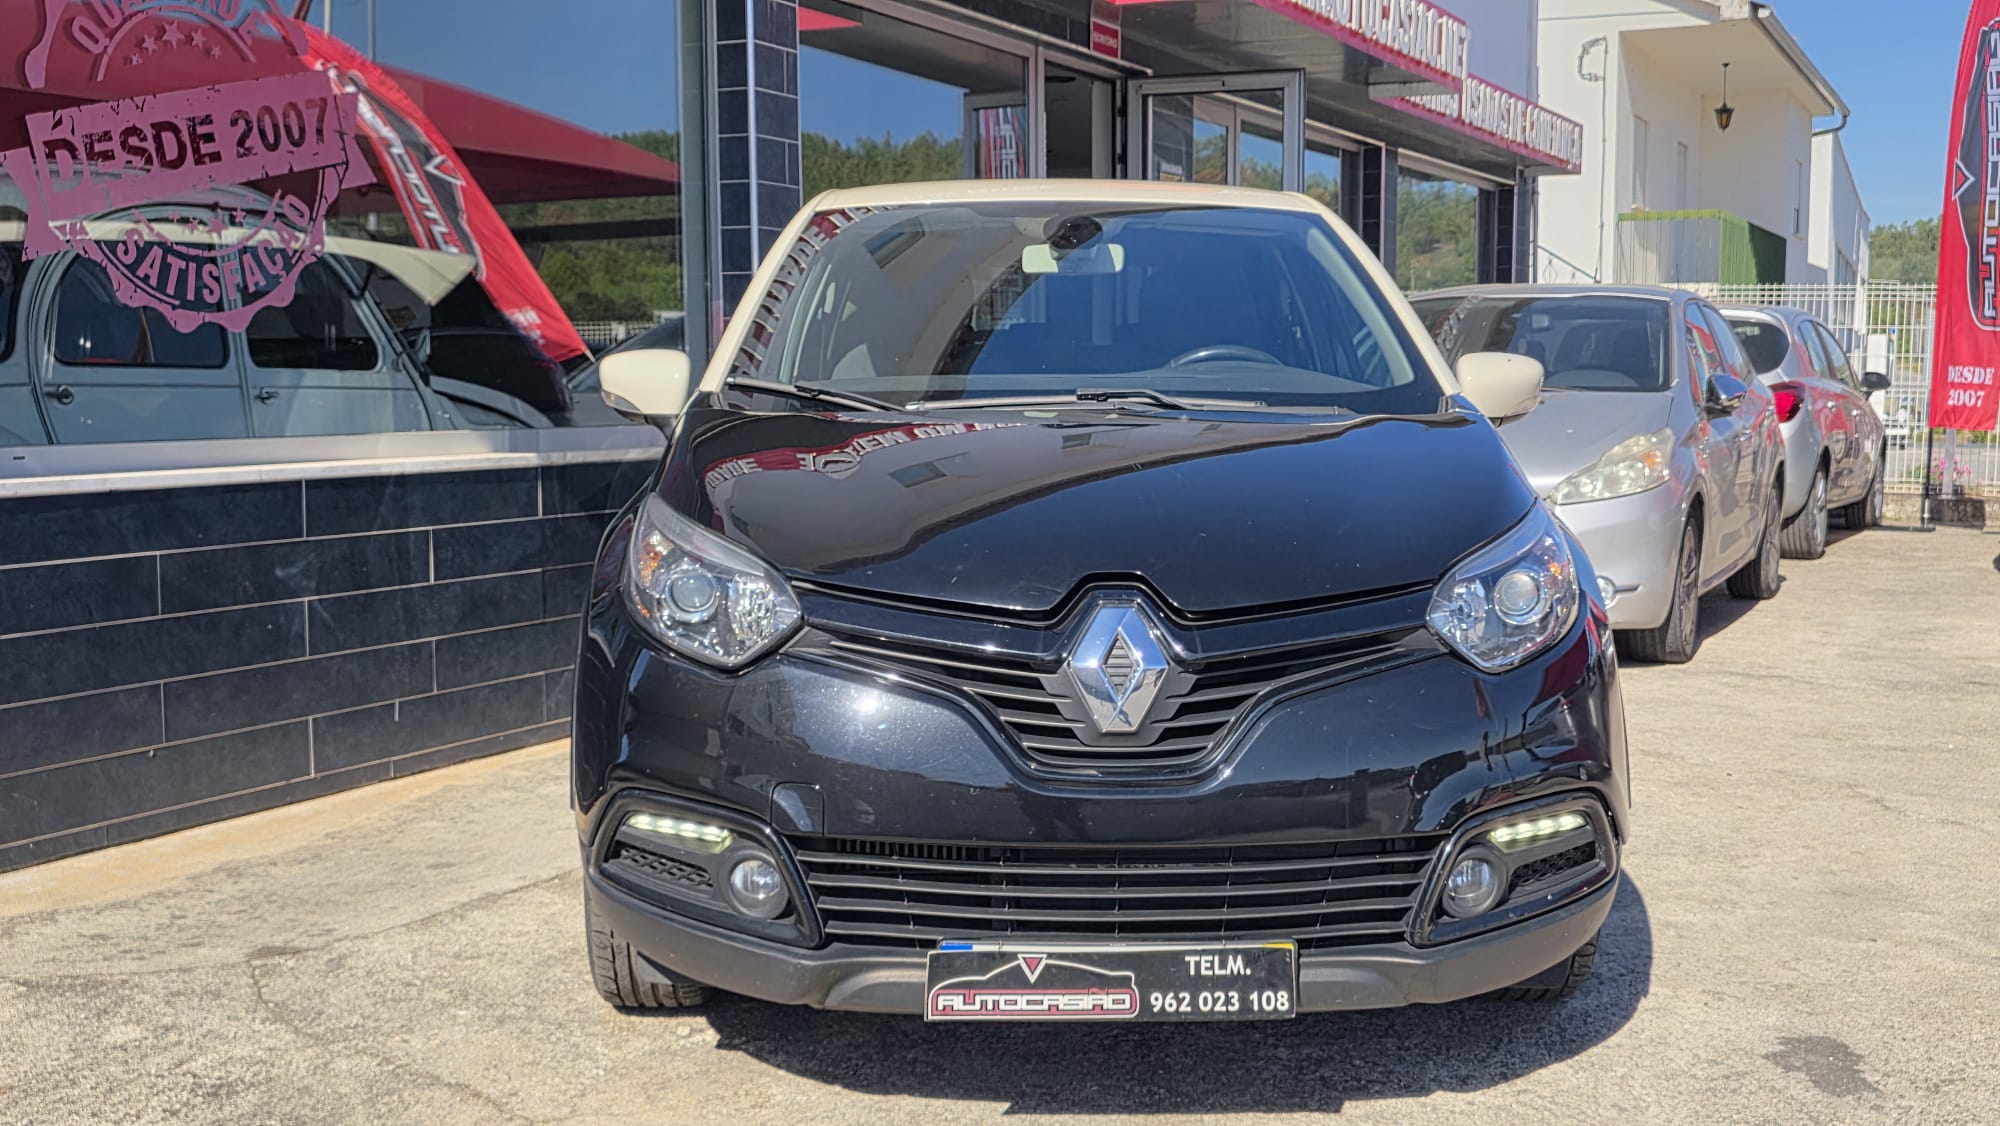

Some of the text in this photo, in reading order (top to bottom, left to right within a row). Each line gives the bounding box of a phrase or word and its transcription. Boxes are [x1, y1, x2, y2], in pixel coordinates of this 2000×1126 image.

[42, 97, 328, 193] DESDE 2007
[1947, 365, 1994, 385] DESDE
[1947, 389, 1984, 408] 2007
[1184, 954, 1252, 976] TELM.
[1150, 990, 1290, 1013] 962 023 108
